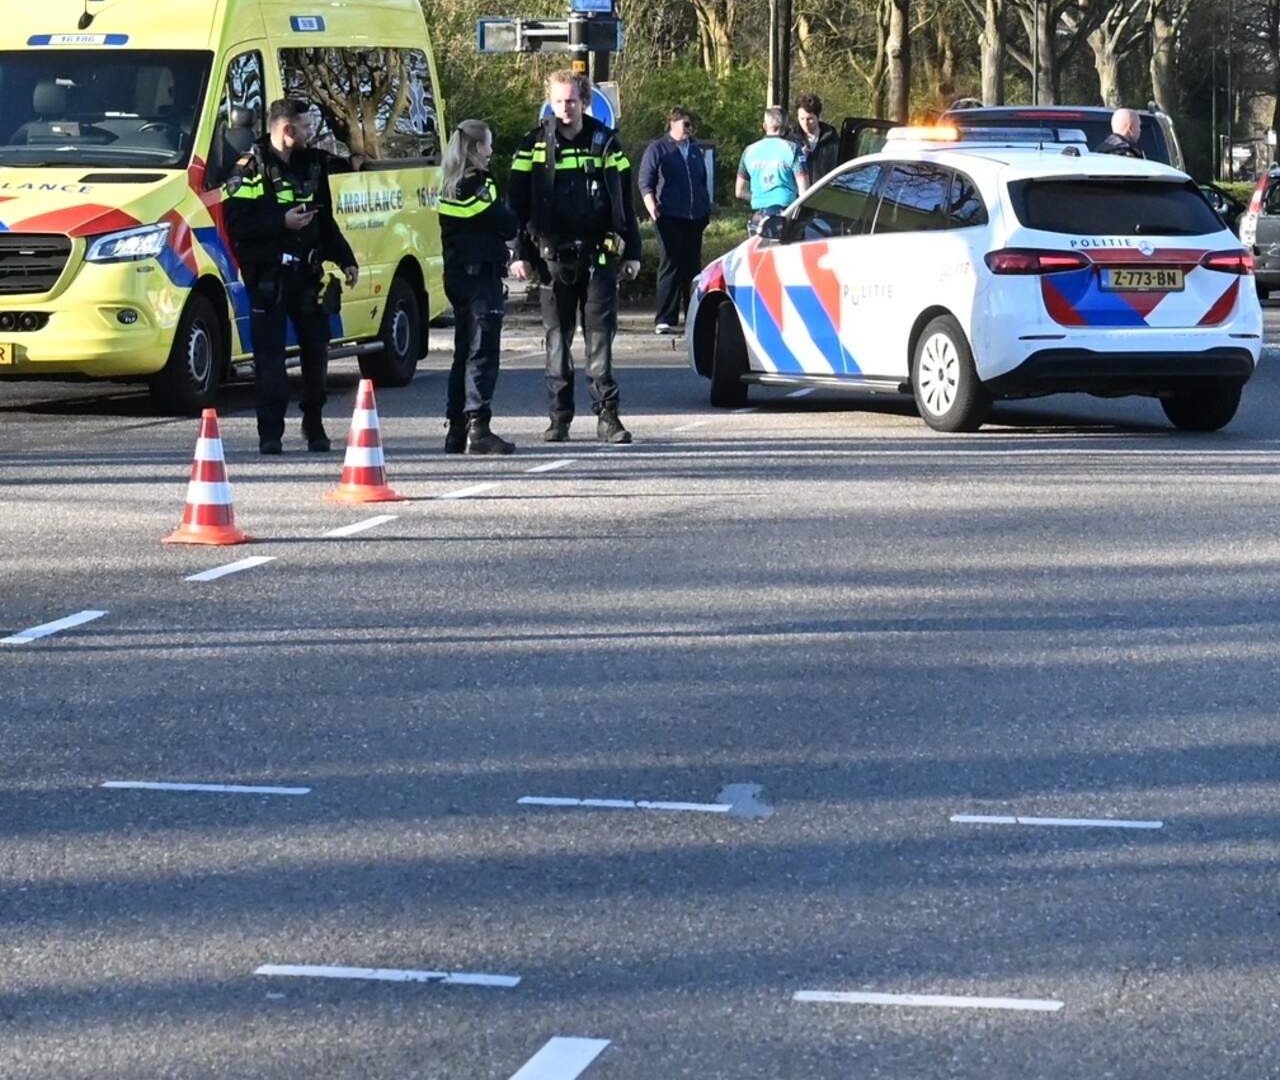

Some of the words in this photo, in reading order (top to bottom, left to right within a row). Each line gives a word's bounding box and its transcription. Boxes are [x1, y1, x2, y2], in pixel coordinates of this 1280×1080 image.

[336, 190, 403, 214] AMBULANCE
[1070, 238, 1133, 248] POLITIE
[1114, 271, 1177, 286] Z-773-BN
